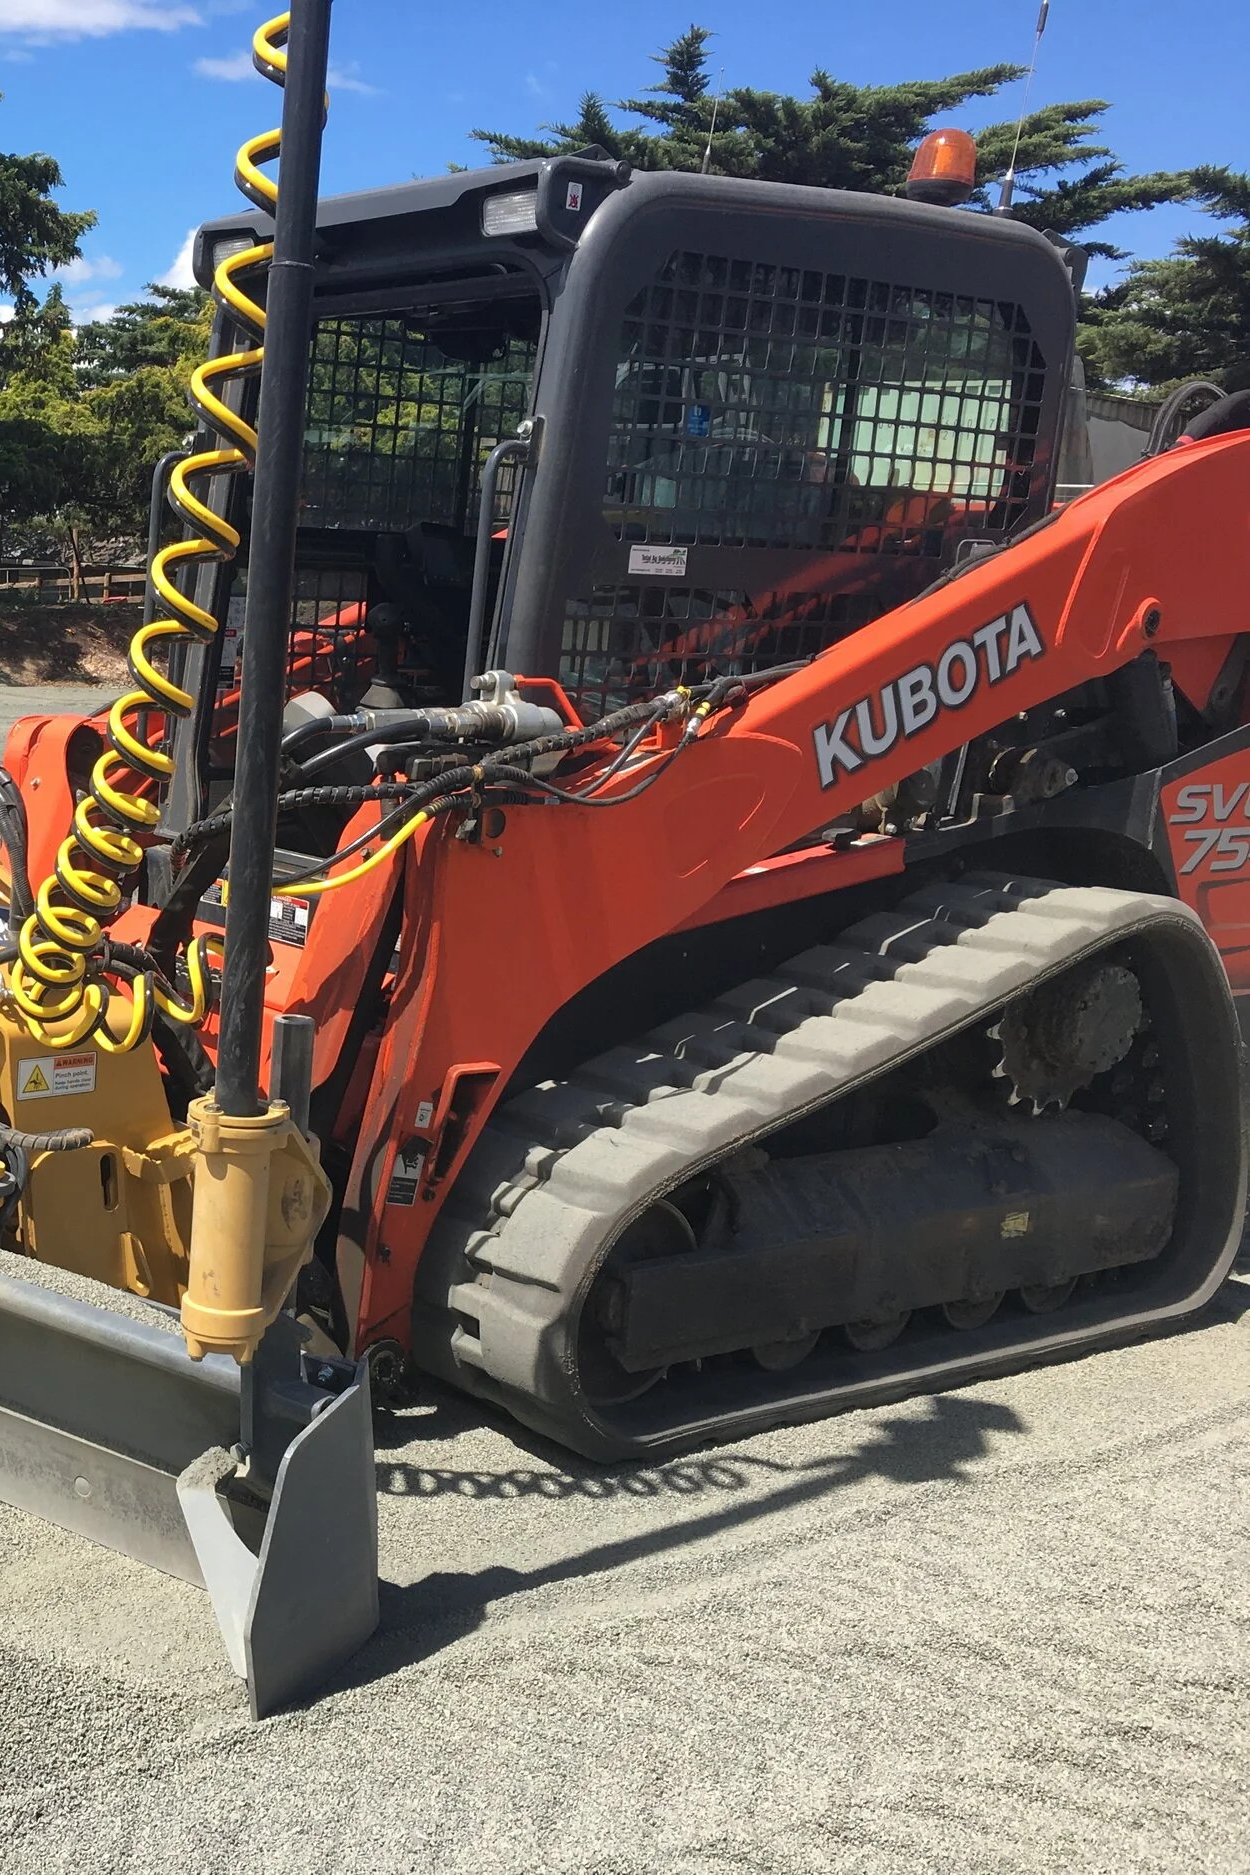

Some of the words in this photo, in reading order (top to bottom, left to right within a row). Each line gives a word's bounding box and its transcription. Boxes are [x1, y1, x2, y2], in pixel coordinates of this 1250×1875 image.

[812, 603, 1043, 790] KUBOTA
[62, 1056, 94, 1067] WARNING
[55, 1070, 71, 1079] Pinch
